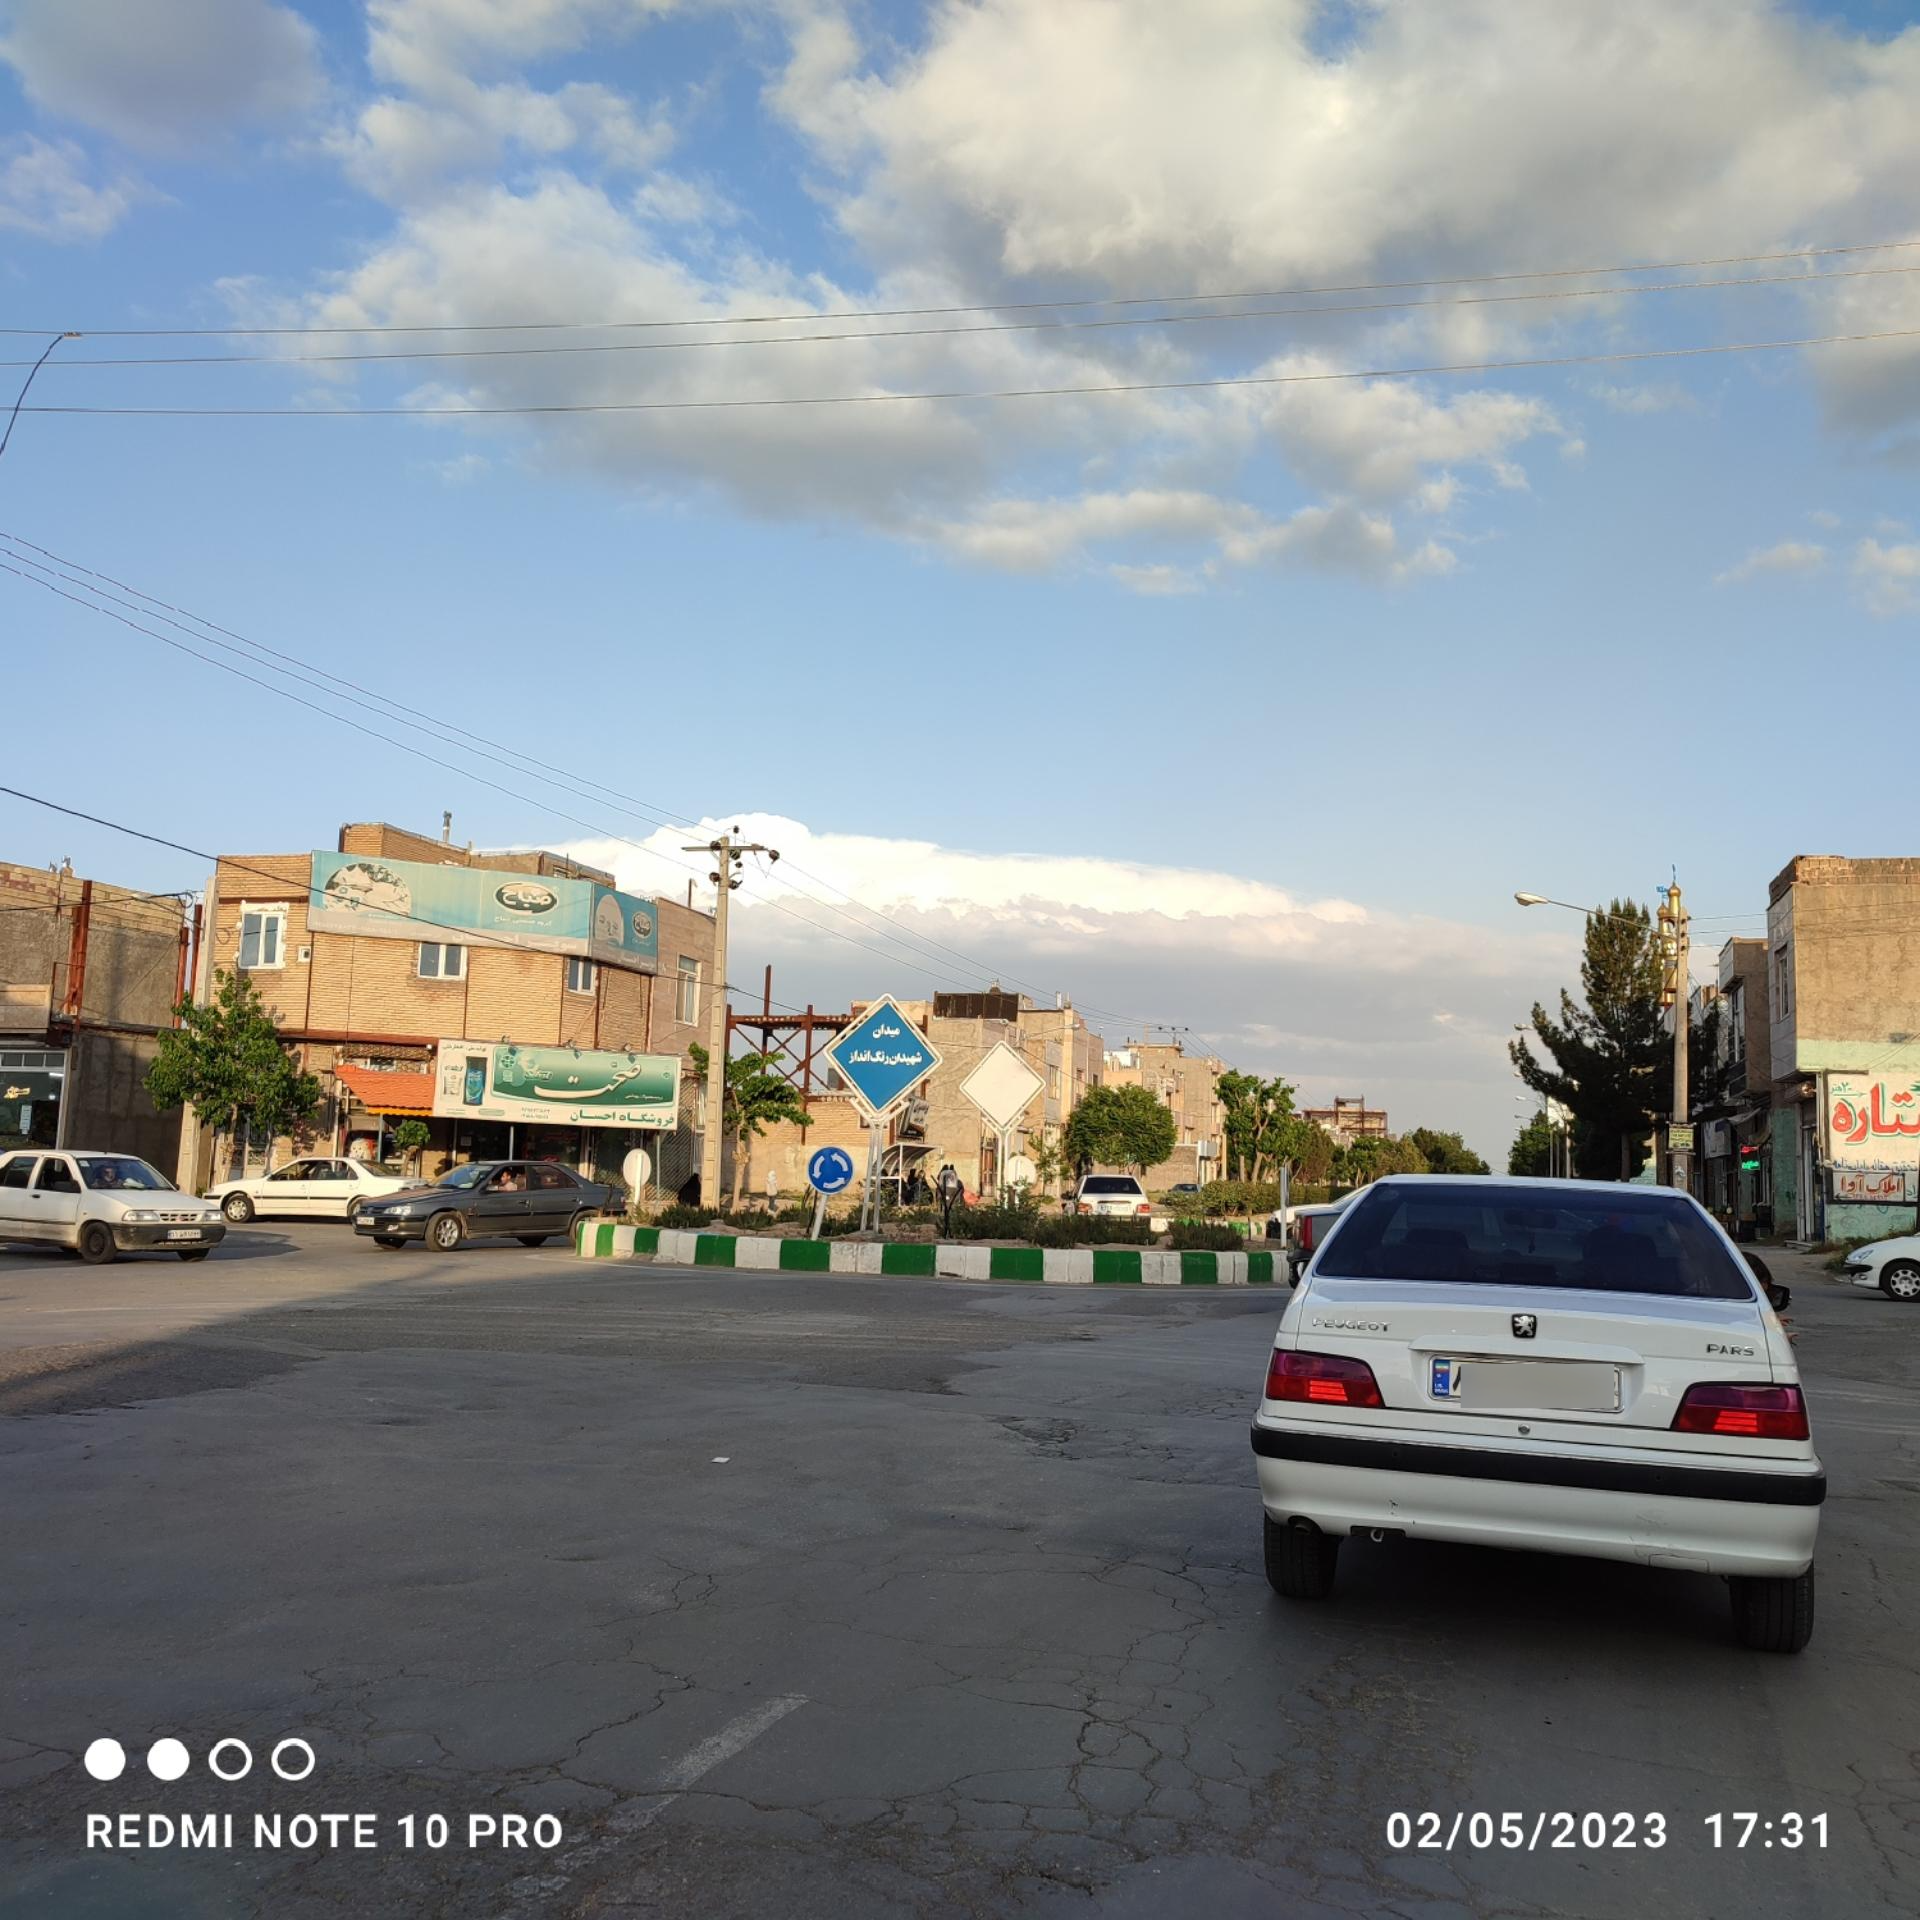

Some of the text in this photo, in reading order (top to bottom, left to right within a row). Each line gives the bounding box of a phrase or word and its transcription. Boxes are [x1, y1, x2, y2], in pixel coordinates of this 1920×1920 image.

[501, 885, 552, 908] صباح
[872, 1024, 901, 1038] میدان
[888, 1050, 922, 1065] شهیدان
[570, 1109, 674, 1127] فروشگاه احسان
[1832, 1083, 1920, 1143] تاره
[1841, 1172, 1901, 1194] املاک آوا
[1311, 1317, 1392, 1332] PEUGEOT
[1706, 1343, 1755, 1357] PARS
